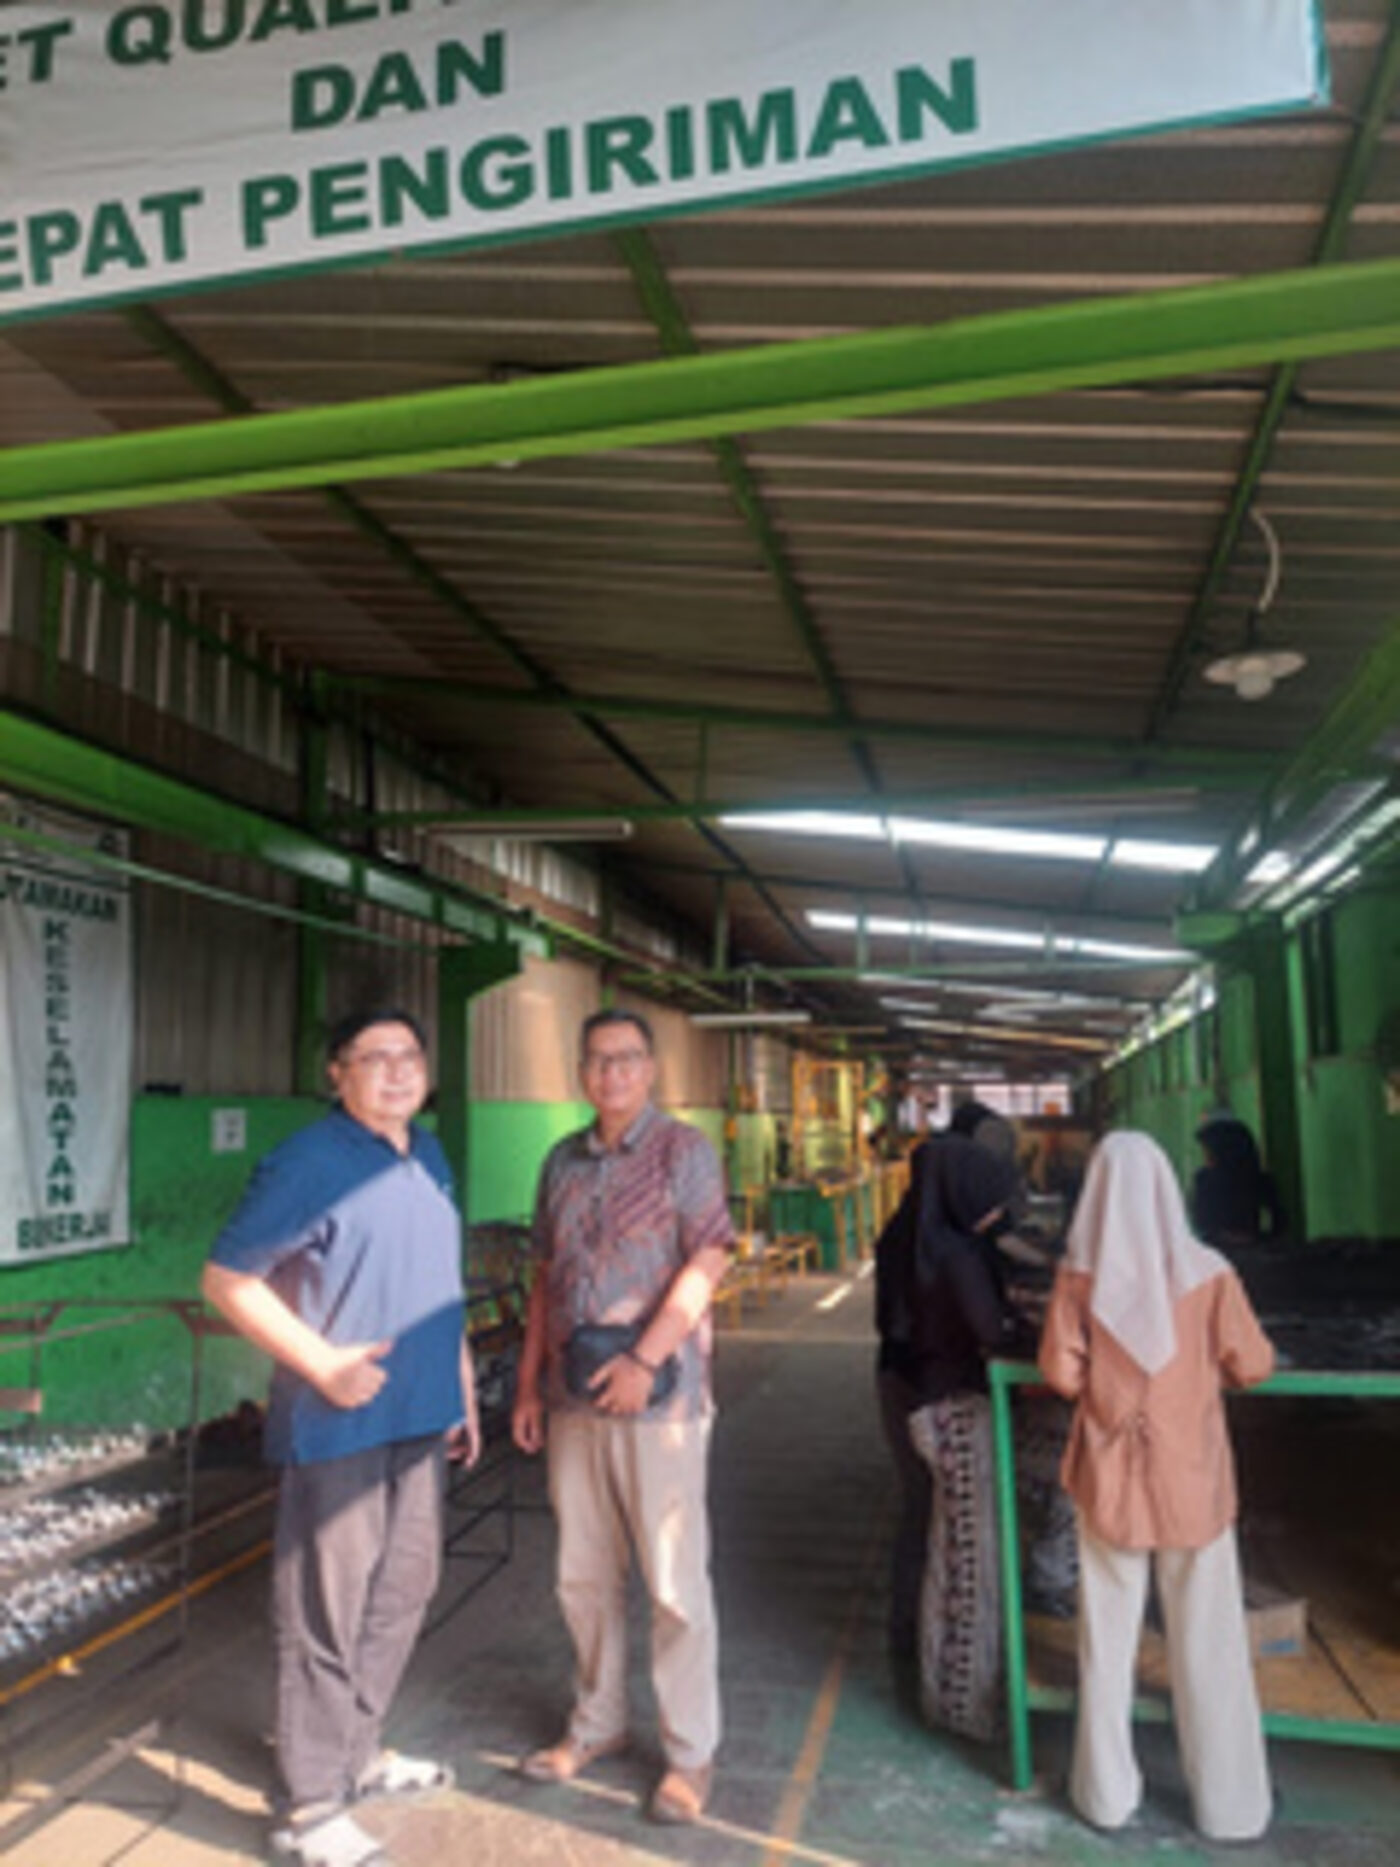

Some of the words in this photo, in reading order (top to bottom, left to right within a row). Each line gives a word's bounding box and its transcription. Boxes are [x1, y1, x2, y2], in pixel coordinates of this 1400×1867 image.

[240, 56, 980, 250] PENGIRIMAN
[290, 29, 508, 133] DAN
[45, 918, 76, 1205] KESELAMATAN
